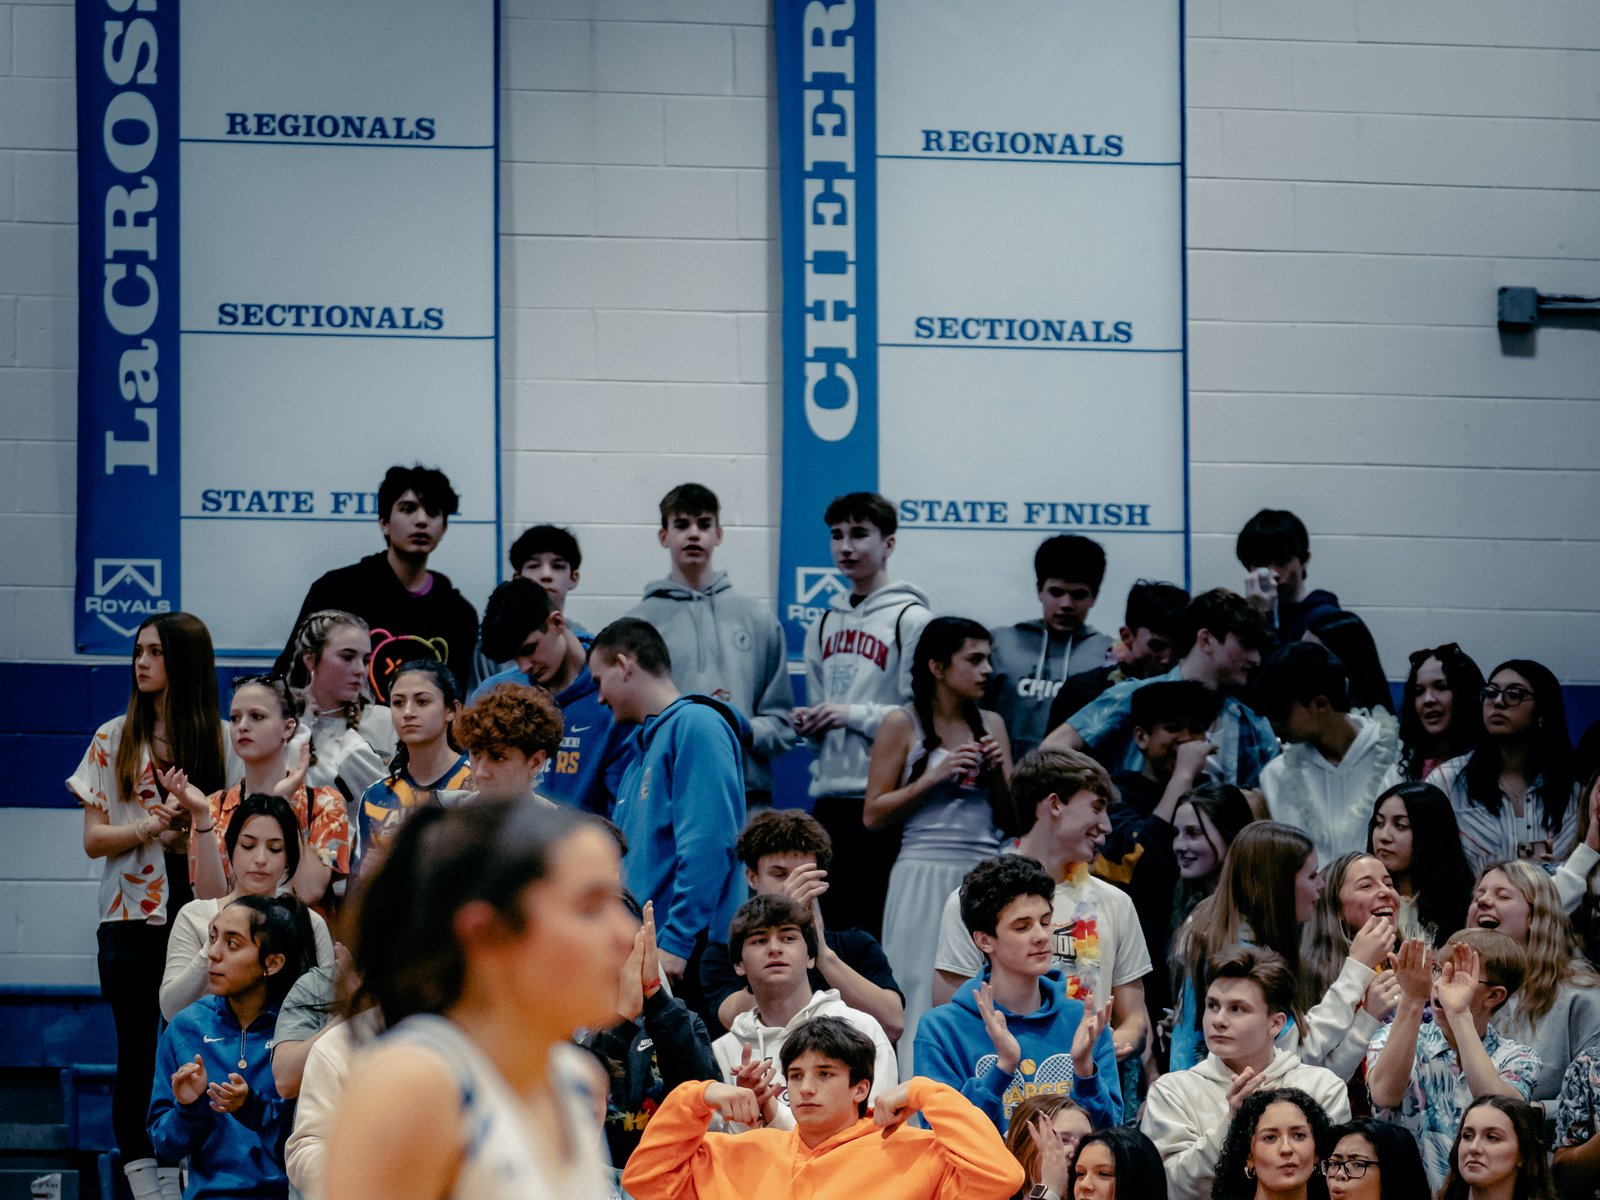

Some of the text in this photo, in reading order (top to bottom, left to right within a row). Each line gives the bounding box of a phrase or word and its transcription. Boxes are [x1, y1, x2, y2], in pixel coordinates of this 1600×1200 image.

[225, 112, 437, 141] REGIONALS
[921, 129, 1124, 157] REGIONALS
[802, 0, 858, 441] CHEER
[104, 0, 159, 475] LaCROS
[217, 302, 445, 331] SECTIONALS
[914, 316, 1134, 343] SECTIONALS
[201, 489, 315, 514] STATE
[899, 499, 1152, 527] STATE FINISH
[85, 596, 171, 614] ROYALS
